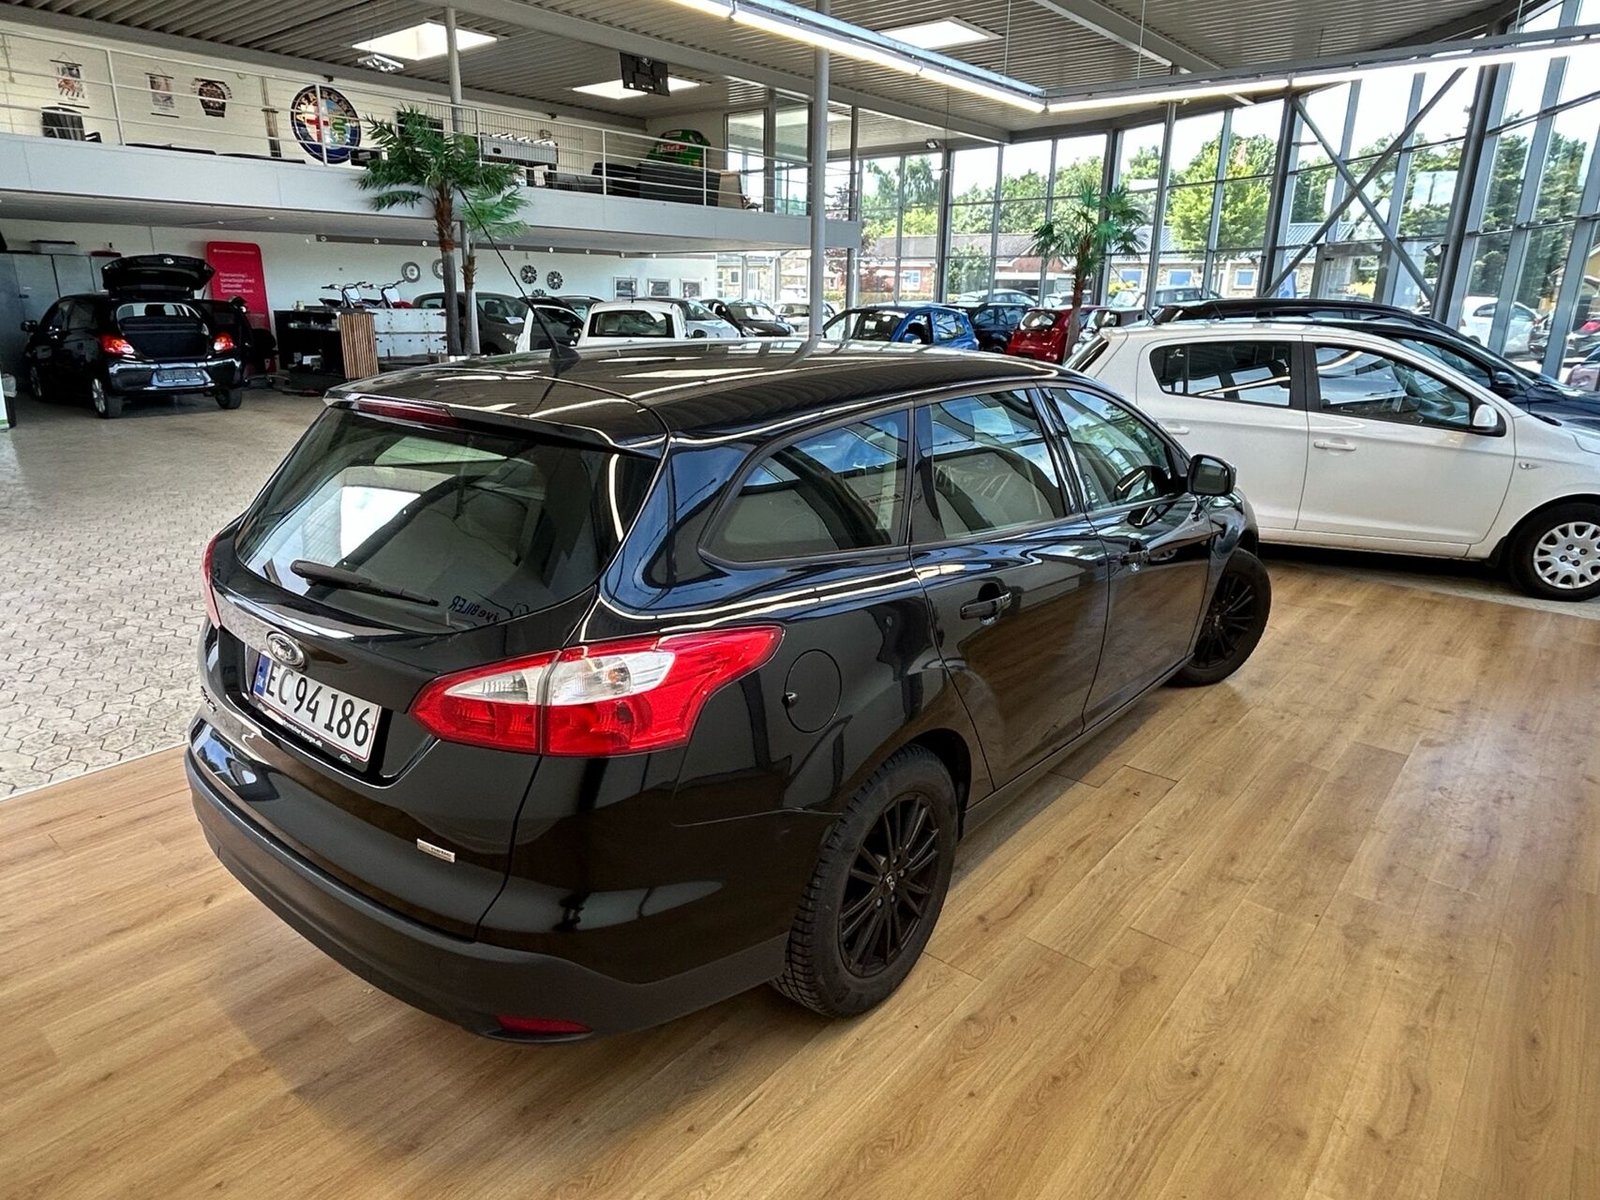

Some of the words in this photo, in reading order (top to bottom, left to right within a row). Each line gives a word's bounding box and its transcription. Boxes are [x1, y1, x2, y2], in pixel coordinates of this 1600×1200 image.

[266, 661, 294, 705] EC
[294, 677, 323, 723] 94
[324, 693, 370, 747] 186
